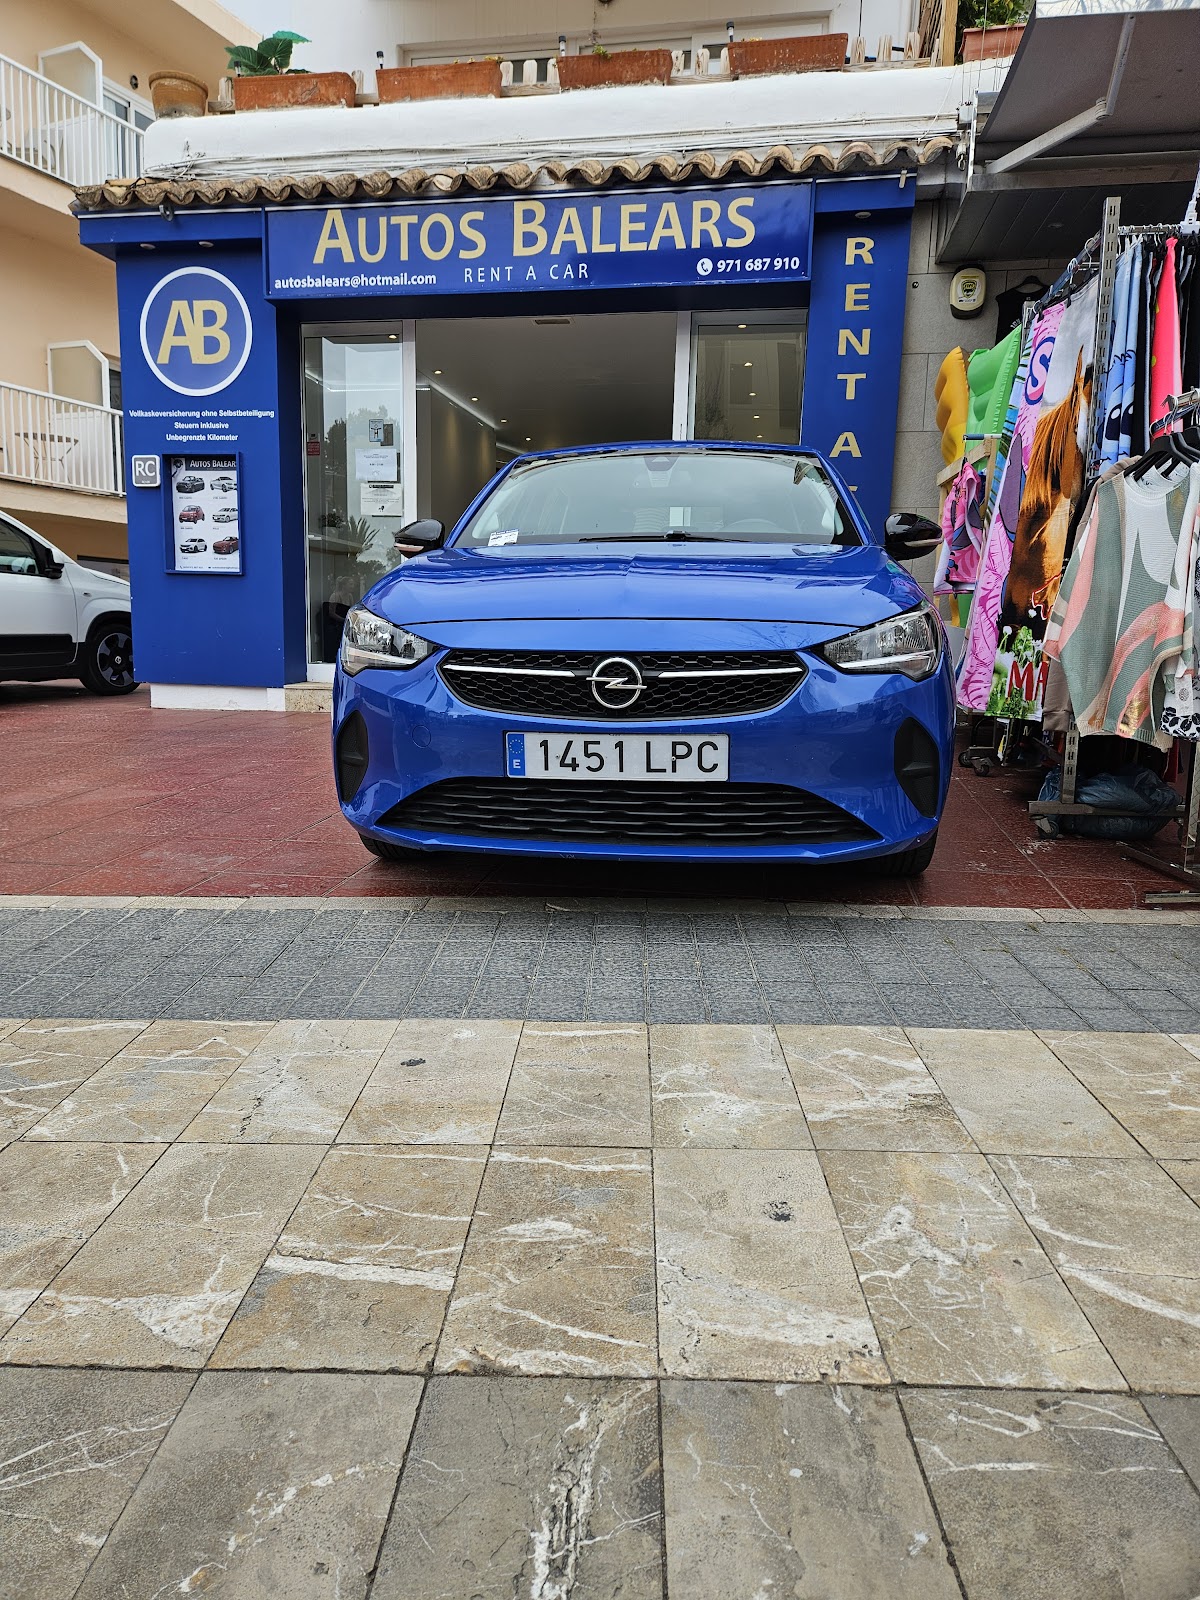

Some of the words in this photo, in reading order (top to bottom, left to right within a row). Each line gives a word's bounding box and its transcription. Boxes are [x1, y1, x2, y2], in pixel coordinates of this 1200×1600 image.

[312, 209, 487, 264] AUTOS
[512, 197, 756, 257] BALEARS
[464, 266, 513, 283] RENT
[526, 265, 536, 281] A
[549, 263, 589, 280] CAR
[716, 259, 741, 273] 971
[744, 258, 771, 272] 687
[773, 256, 800, 270] 910
[274, 272, 437, 289] autosbalears@hotmail.com
[157, 300, 231, 365] AB
[129, 409, 200, 418] Vollkaskoversicherung
[219, 409, 275, 418] Selbstbeteiligung
[166, 433, 206, 442] Unbegrenzte
[207, 433, 238, 441] Kilometer
[135, 460, 156, 477] RC
[190, 459, 211, 468] AUTOS
[512, 759, 521, 769] E
[539, 739, 624, 773] 1451
[645, 740, 719, 774] LPC
